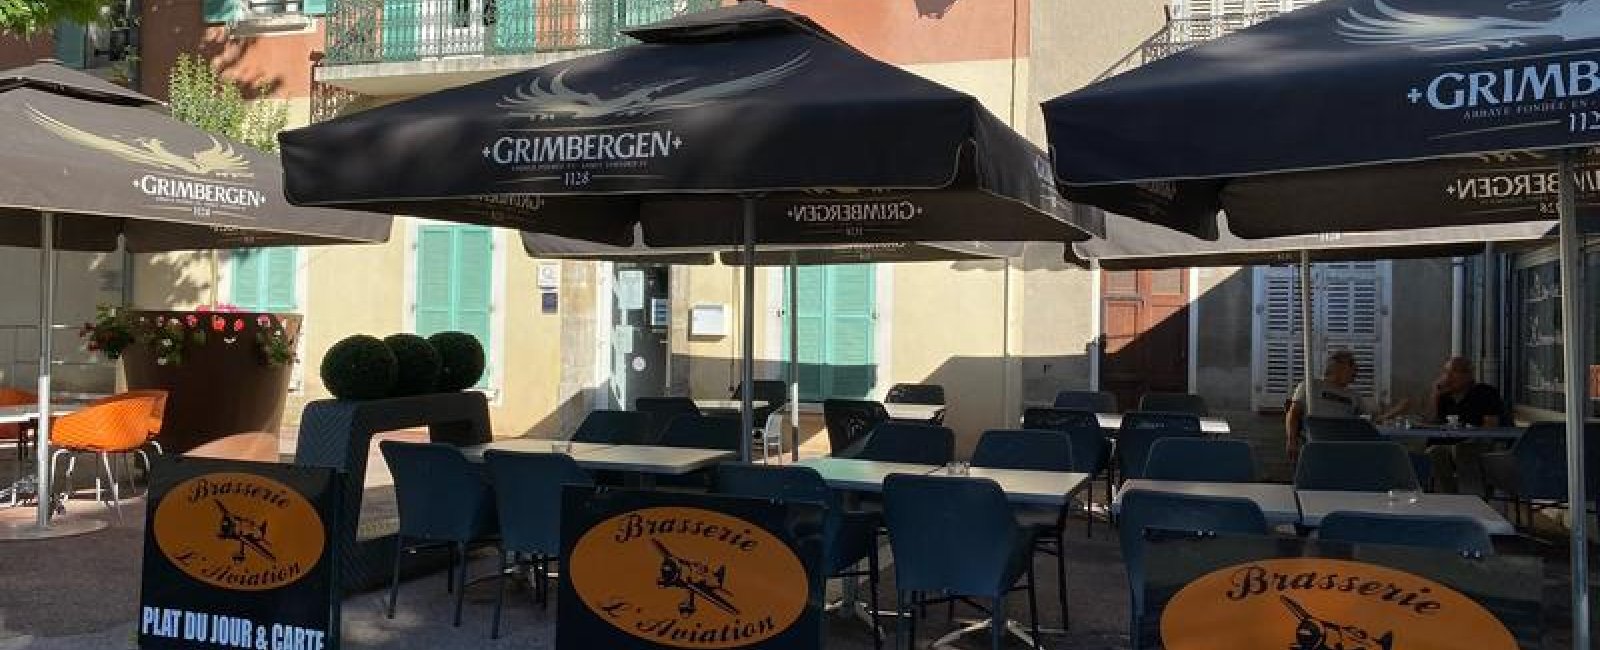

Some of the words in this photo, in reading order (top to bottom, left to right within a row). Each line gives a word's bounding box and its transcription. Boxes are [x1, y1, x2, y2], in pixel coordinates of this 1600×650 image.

[493, 130, 672, 164] GRIMBERGEN
[141, 174, 260, 208] GRIMBERGEN
[188, 478, 290, 508] Brasserie
[615, 513, 759, 551] Brasserie
[1226, 566, 1442, 615] Brasserie
[142, 606, 183, 638] PLAT
[183, 611, 209, 643] DU
[210, 614, 253, 648] JOUR
[255, 625, 269, 650] &
